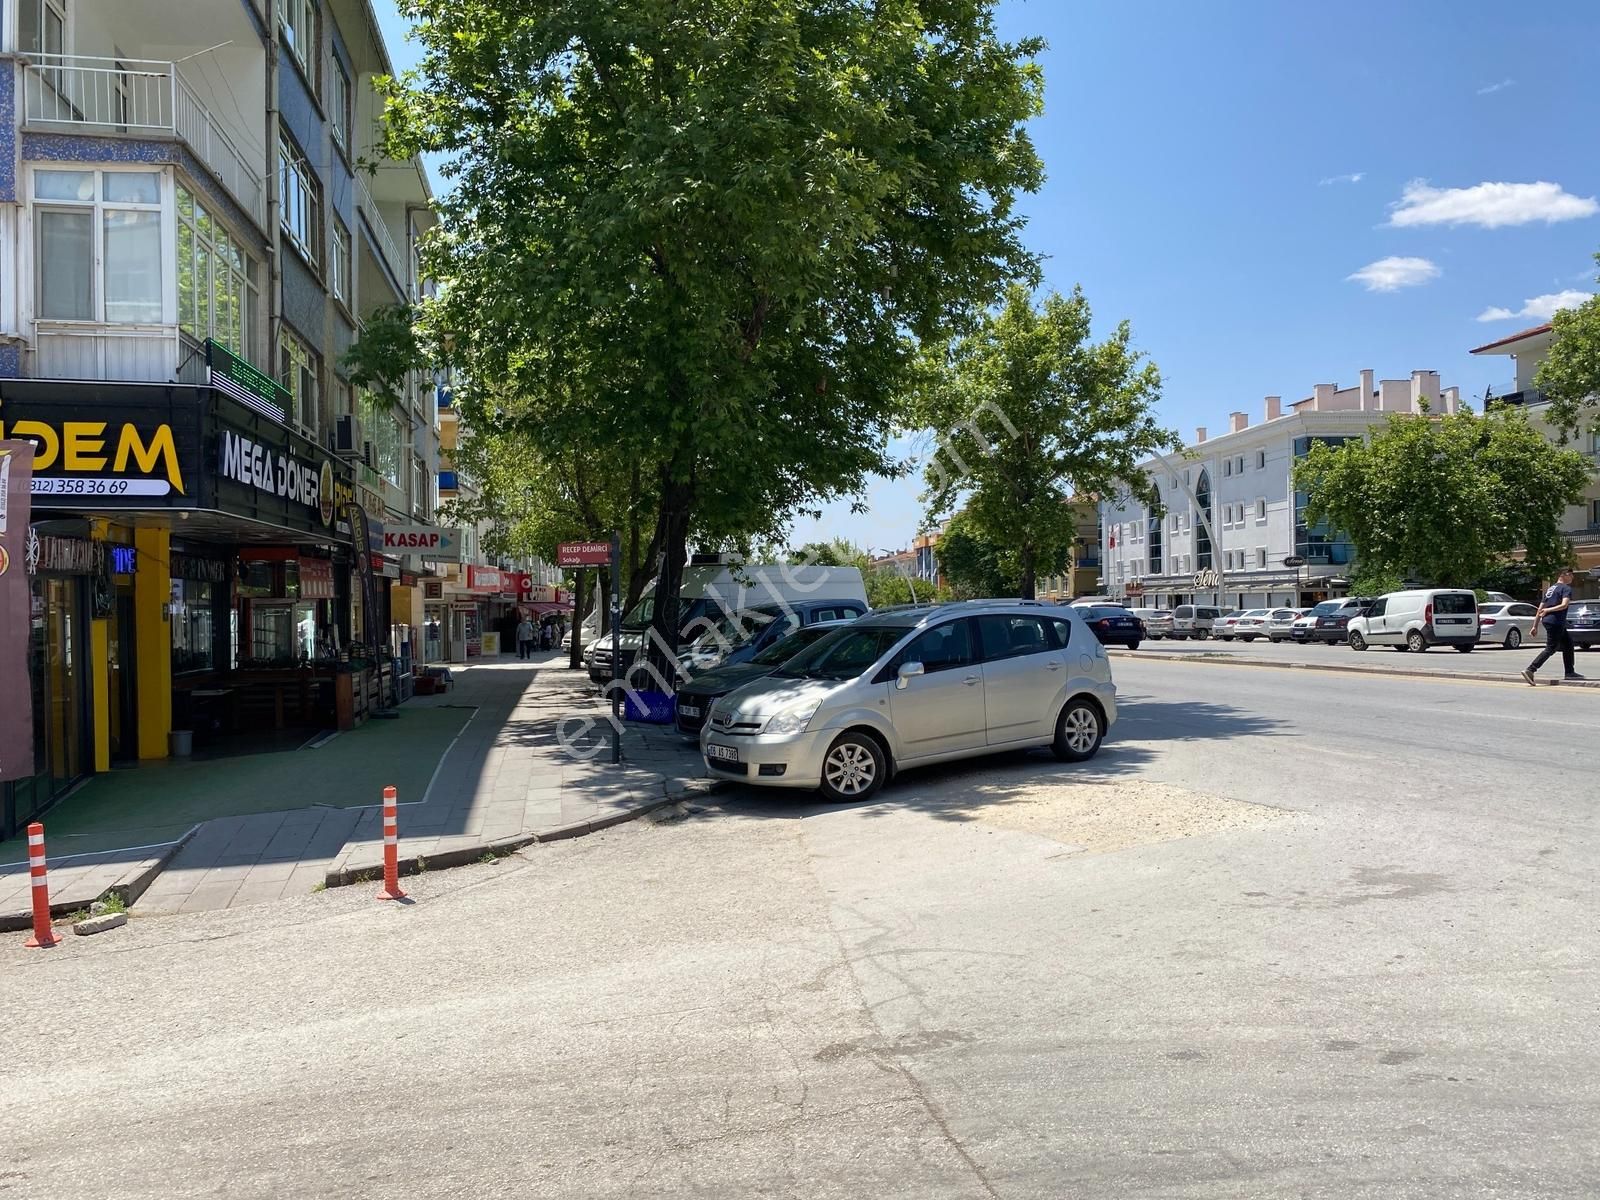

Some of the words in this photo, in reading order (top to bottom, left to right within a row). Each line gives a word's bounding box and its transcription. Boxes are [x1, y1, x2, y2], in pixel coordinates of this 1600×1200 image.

[223, 430, 275, 493] MEGA
[277, 445, 319, 508] DÖNER
[56, 480, 84, 494] 358
[87, 480, 105, 494] 36
[109, 480, 128, 494] 69
[384, 533, 439, 547] KASAP
[582, 544, 608, 553] DEMİRCİ
[562, 556, 581, 564] Sokağı
